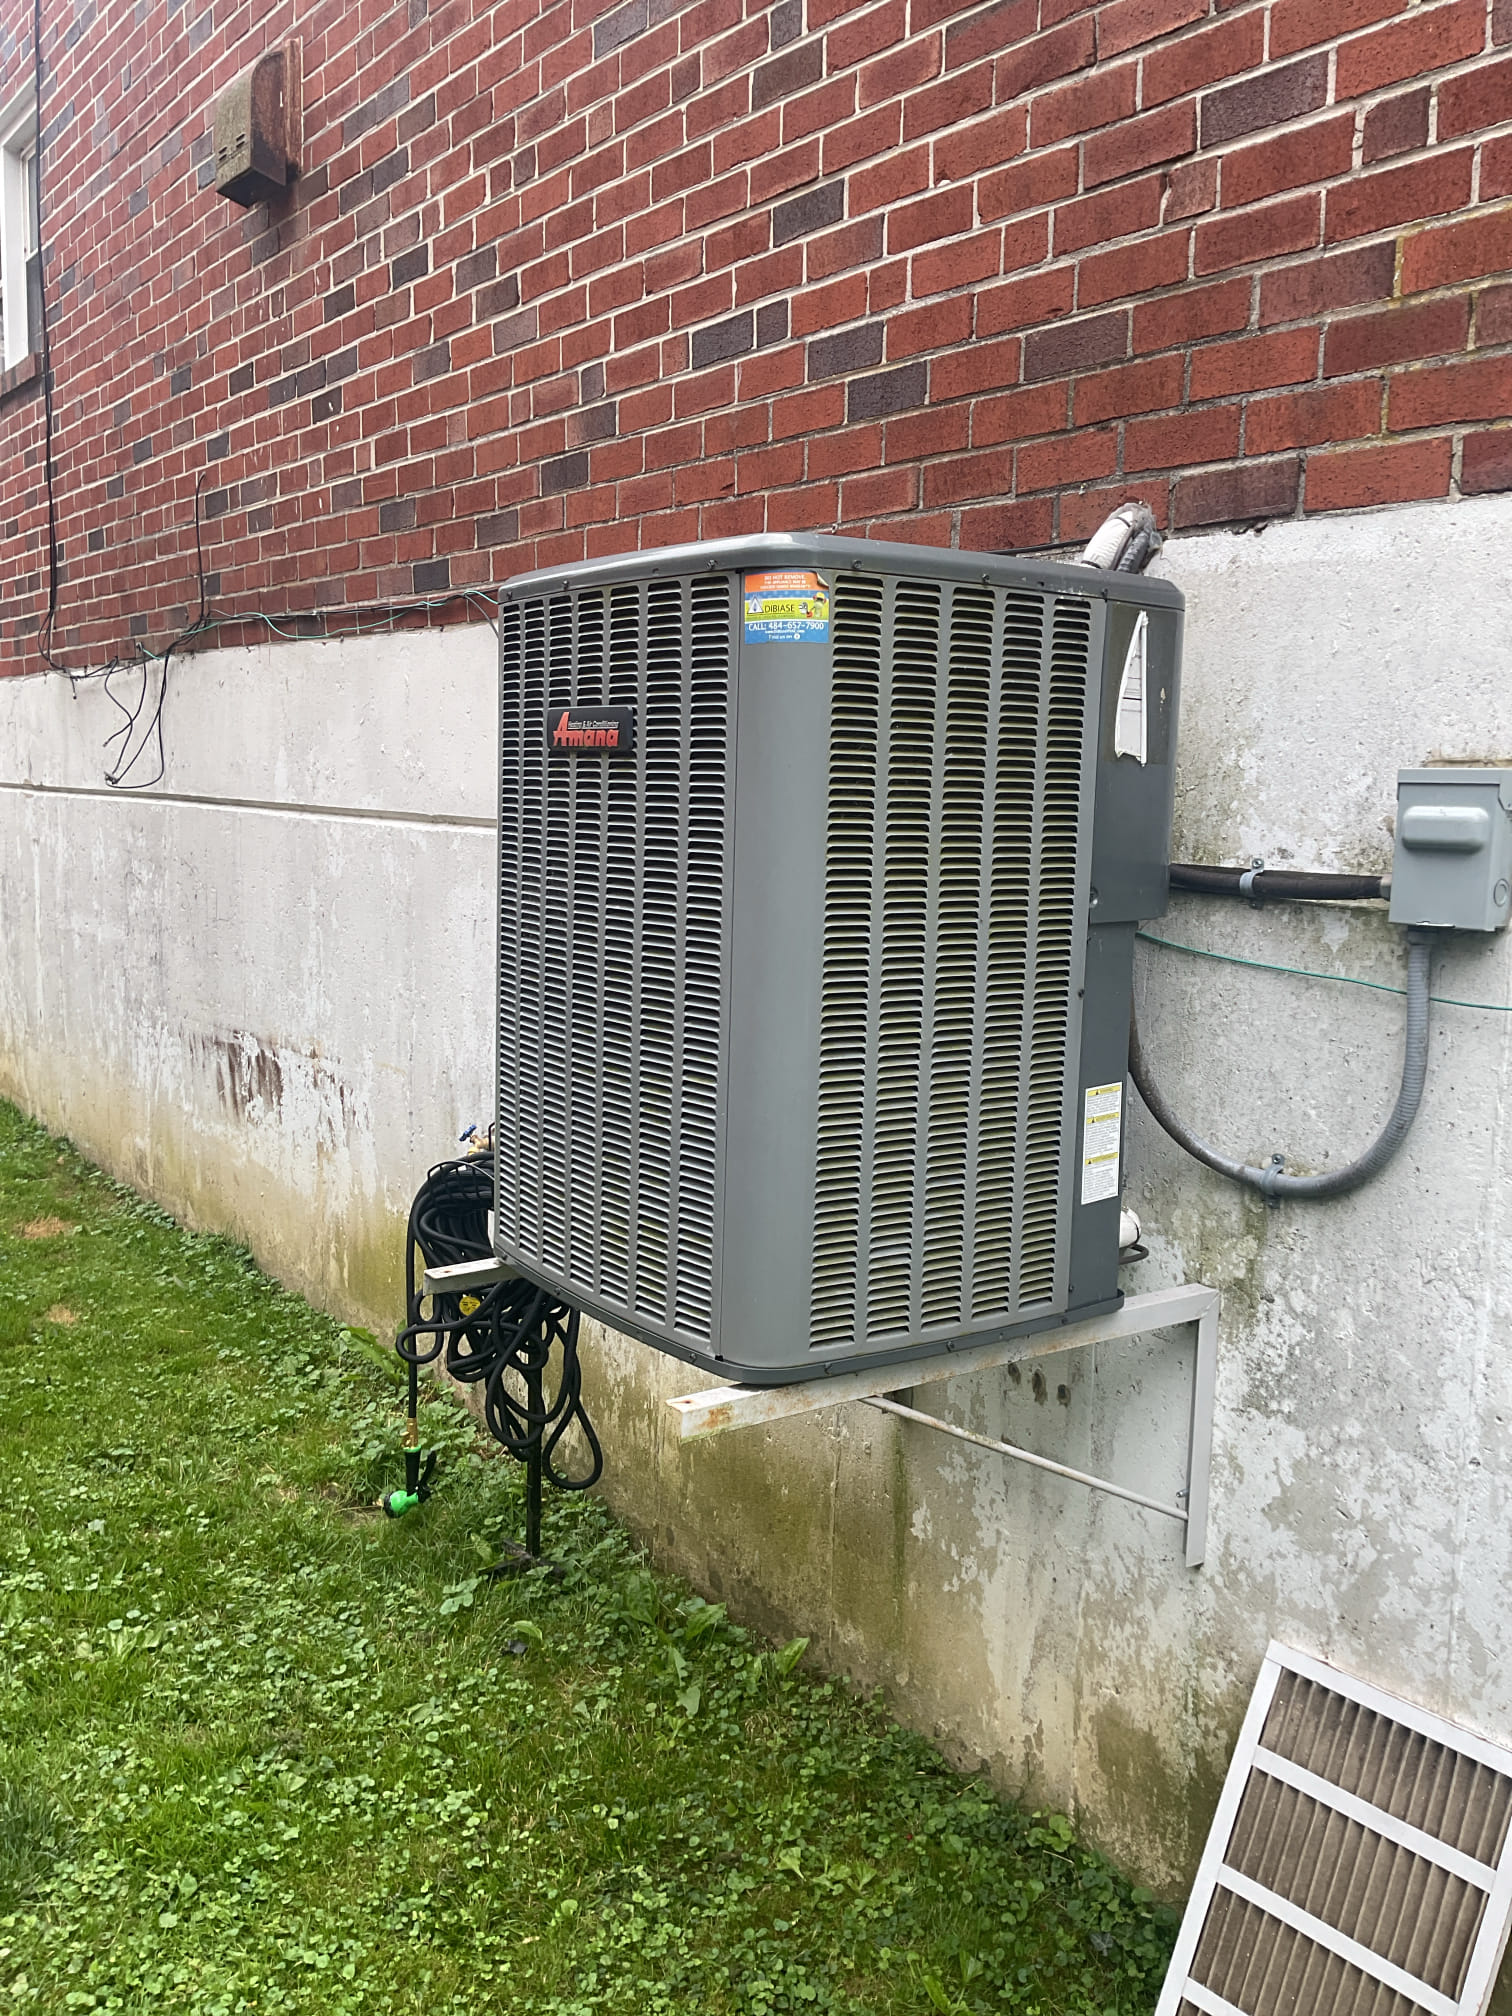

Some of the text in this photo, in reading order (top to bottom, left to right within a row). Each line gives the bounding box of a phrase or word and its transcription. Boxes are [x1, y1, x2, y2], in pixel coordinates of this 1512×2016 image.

[764, 604, 795, 613] DIBIASE
[748, 622, 824, 631] CALL: 484-657-7900
[553, 711, 619, 747] Amana
